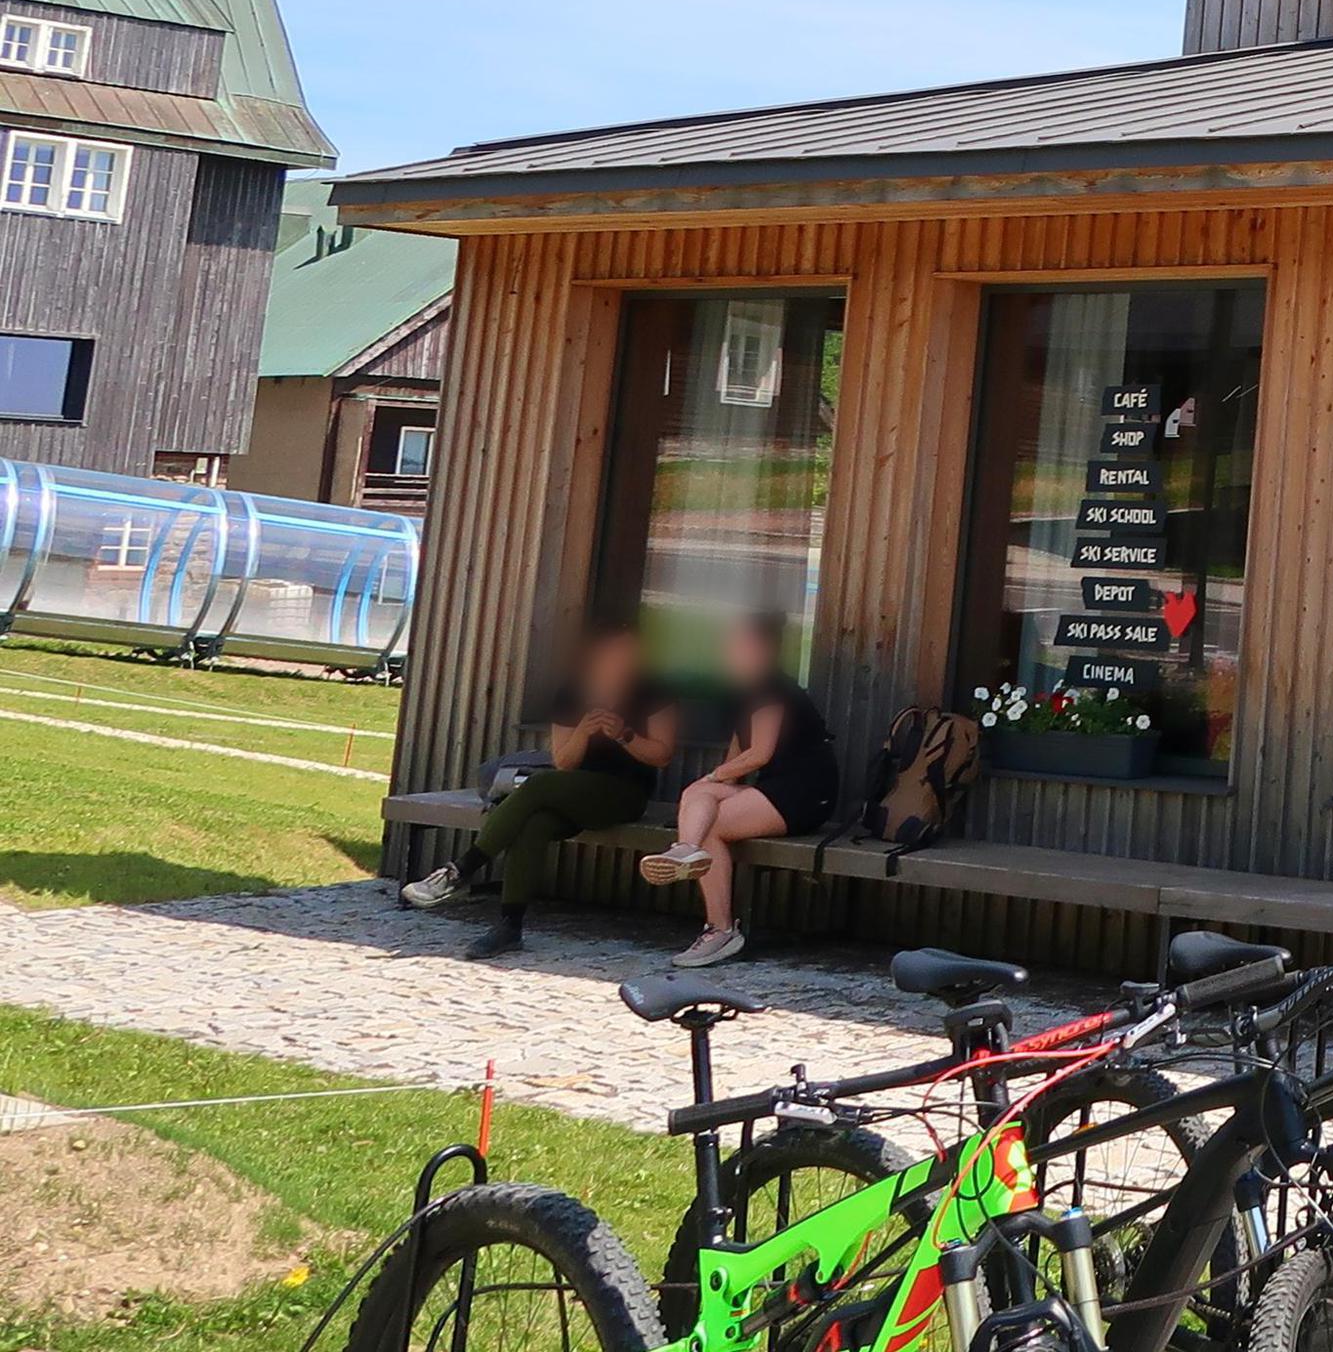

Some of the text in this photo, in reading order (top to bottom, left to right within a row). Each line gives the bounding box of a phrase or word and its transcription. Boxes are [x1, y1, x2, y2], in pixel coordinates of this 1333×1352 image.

[1114, 389, 1148, 408] CAFÉ
[1112, 431, 1144, 447] SHOP
[1099, 468, 1150, 485] RENTAL
[1086, 507, 1156, 524] SKI SCHOOL
[1080, 546, 1156, 563] SKI SERVICE
[1095, 584, 1135, 602] DEPOT
[1067, 622, 1157, 642] SKI PASS SALE
[1083, 663, 1134, 684] CINEMA
